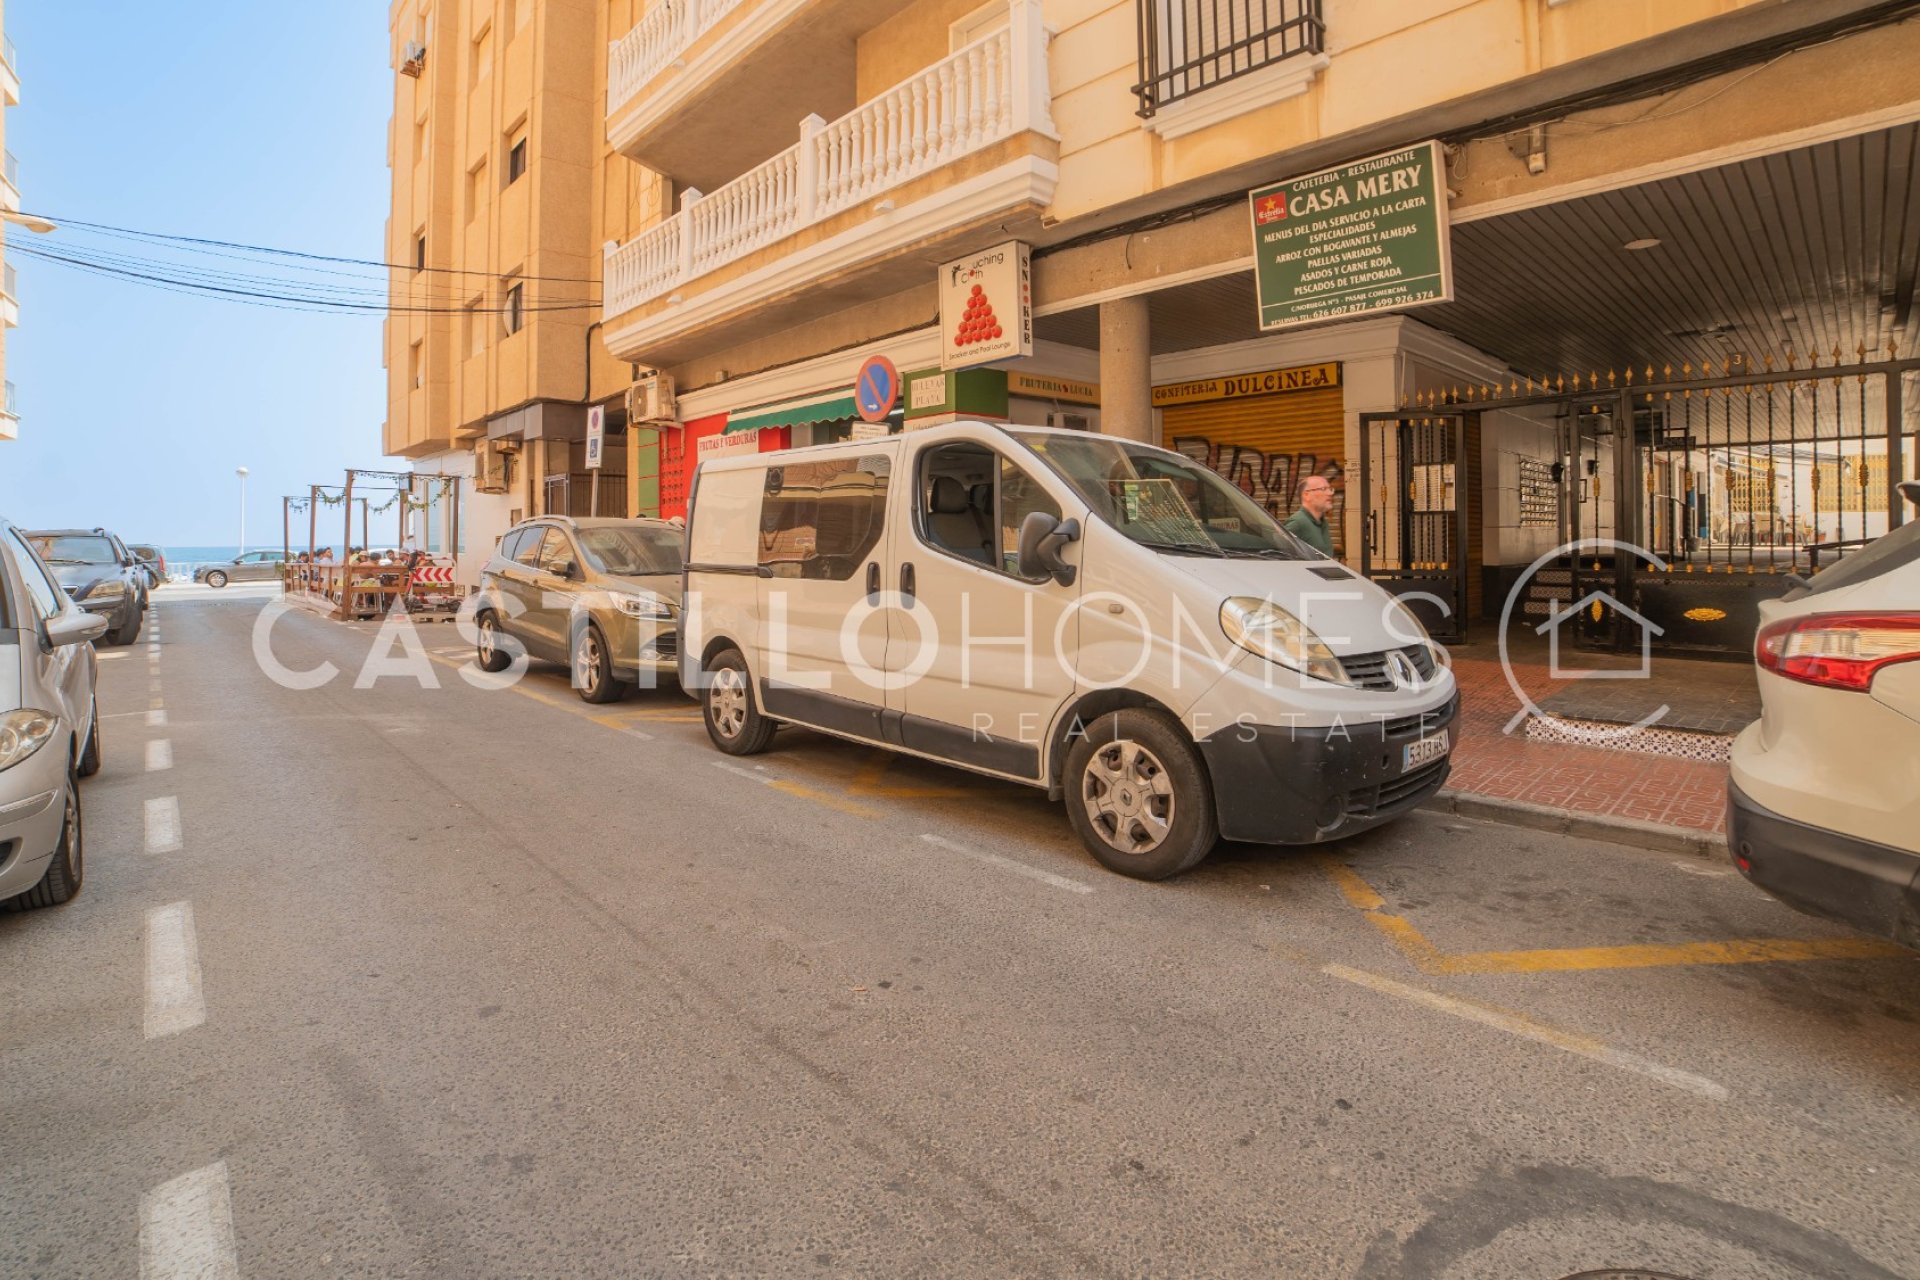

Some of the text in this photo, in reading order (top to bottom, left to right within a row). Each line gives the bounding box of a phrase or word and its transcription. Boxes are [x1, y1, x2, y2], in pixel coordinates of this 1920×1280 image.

[1293, 151, 1416, 192] CAFETERIA RESTAURANTE
[1290, 165, 1422, 217] CASA MERY
[1258, 207, 1285, 220] Estrella
[1264, 229, 1293, 244] MENUS
[1294, 225, 1310, 236] DEL
[1329, 210, 1371, 228] SERVICIO
[1373, 208, 1380, 217] A
[1382, 204, 1393, 215] LA
[1395, 196, 1427, 212] CARTA
[1275, 224, 1417, 264] ARROZ CON BOGAVANTE Y ALMEJAS
[1310, 221, 1376, 244] ESPECIALIDADES
[1300, 256, 1393, 282] ASADOS Y CARNE ROJA
[1308, 245, 1383, 269] PAELLAS VARIADAS
[1294, 267, 1402, 296] PESCADOS DE TEMPORADA
[1368, 286, 1408, 298] COMERCIAL
[1313, 309, 1330, 318] 626
[1331, 306, 1347, 315] 607
[1375, 298, 1392, 307] 699
[1416, 290, 1434, 300] 374
[1733, 354, 1742, 365] 3
[1223, 368, 1330, 396] DULCINEA
[1409, 741, 1432, 767] 5313
